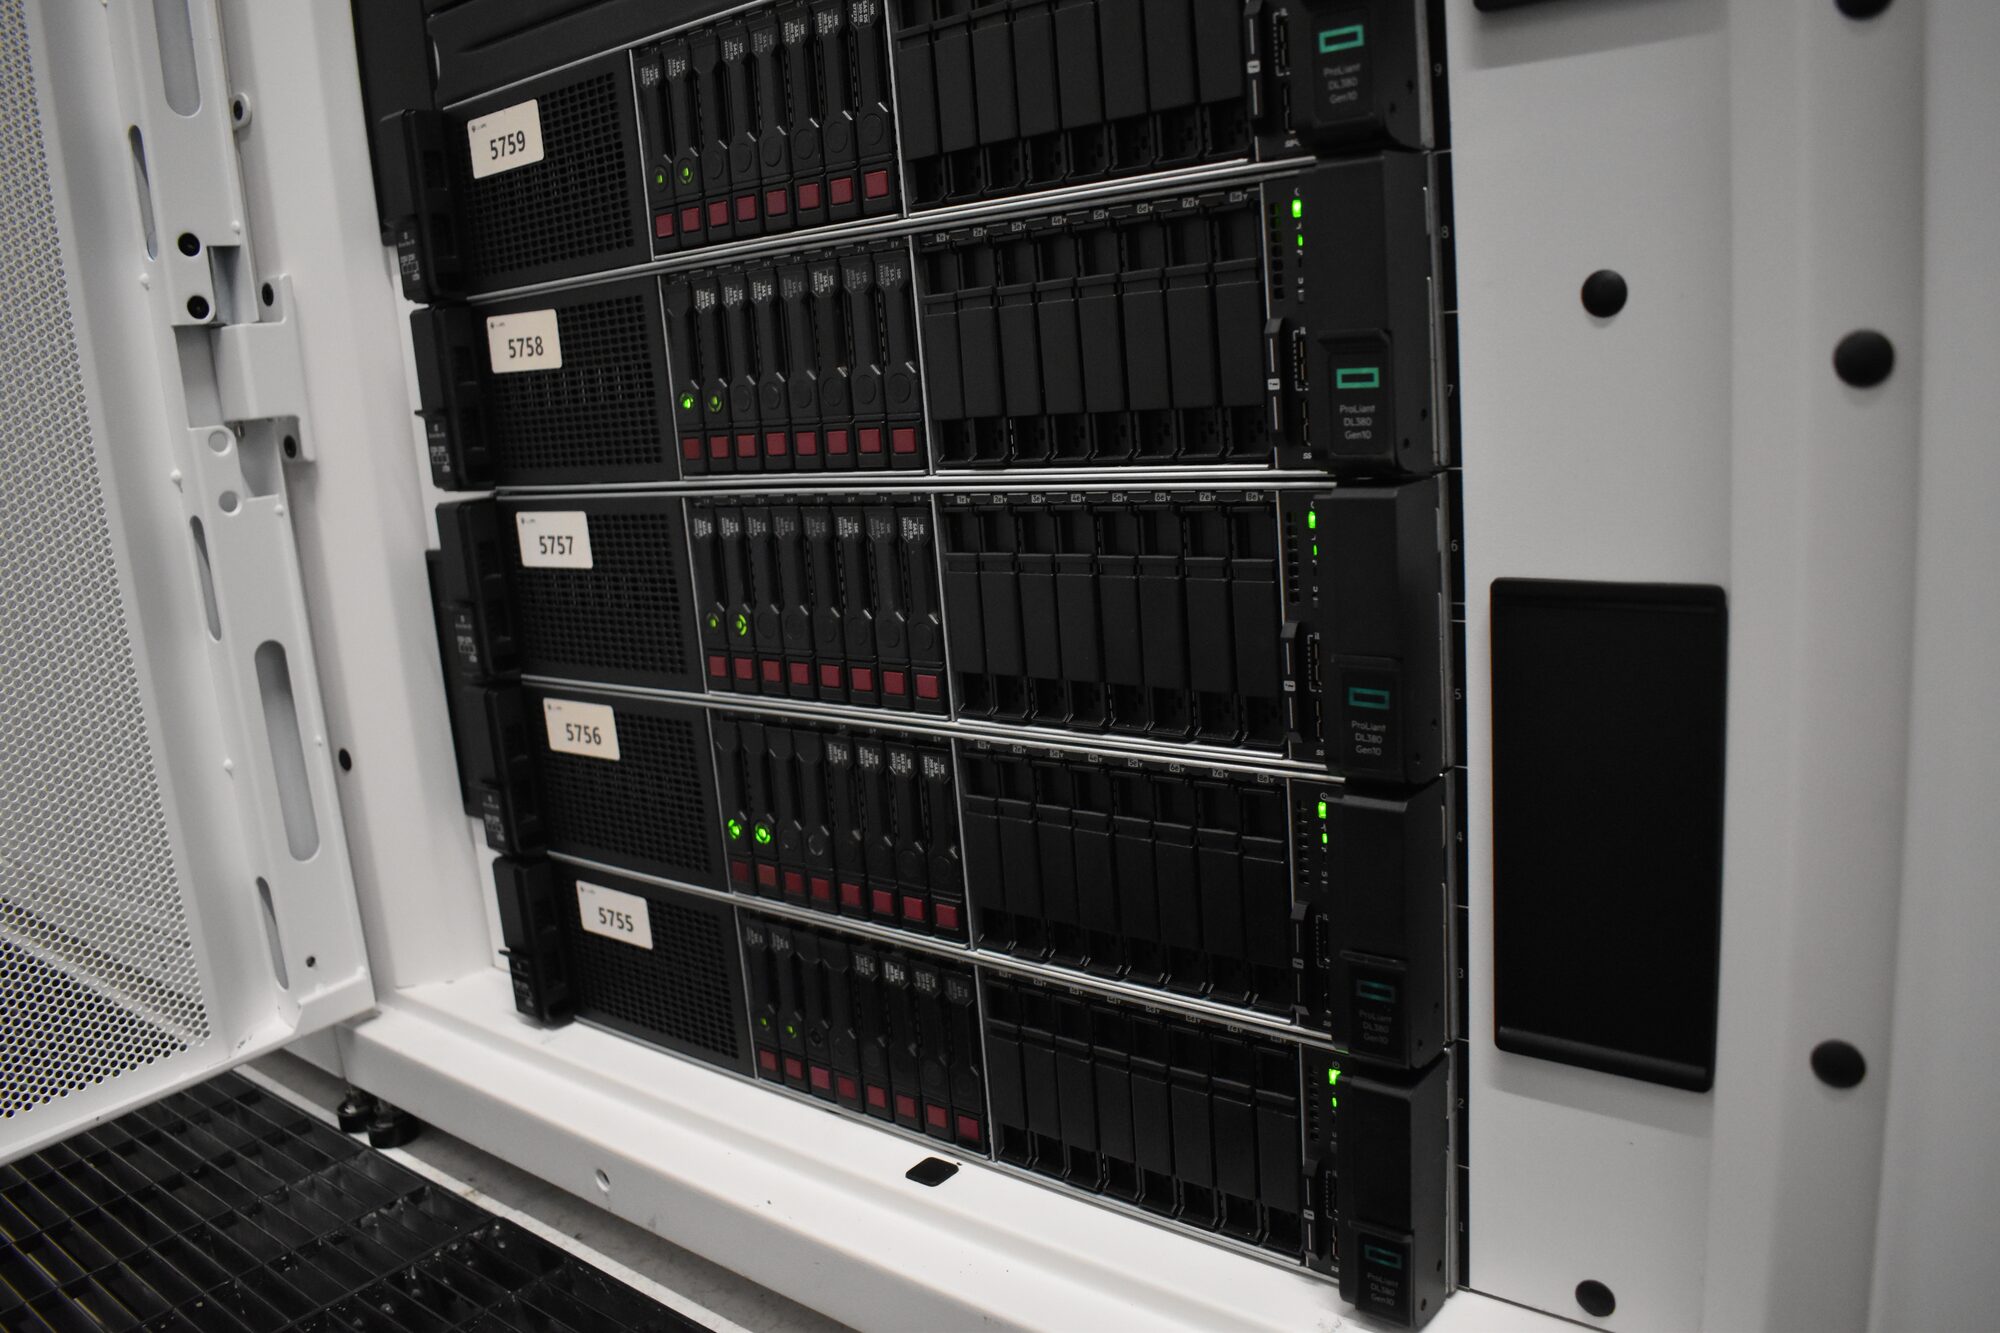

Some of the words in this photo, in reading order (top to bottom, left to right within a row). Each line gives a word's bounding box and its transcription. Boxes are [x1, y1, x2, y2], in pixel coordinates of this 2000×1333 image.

[1323, 62, 1361, 78] ProLiant
[1434, 63, 1442, 77] 9
[1328, 76, 1358, 91] DL380
[1328, 90, 1359, 104] Gen10
[490, 130, 525, 160] 5759
[1441, 225, 1449, 239] 8
[508, 336, 544, 359] 5758
[1448, 384, 1454, 397] 7
[1339, 403, 1376, 414] ProLiant
[1343, 416, 1373, 427] DL380
[1344, 430, 1373, 440] Gen10
[539, 535, 573, 555] 5757
[1451, 539, 1458, 552] 6
[1454, 688, 1462, 700] 5
[1351, 720, 1386, 733] ProLiant
[566, 723, 601, 745] 5756
[1354, 732, 1383, 744] DL380
[1355, 744, 1382, 756] Gen10
[599, 907, 633, 932] 5755
[1457, 967, 1464, 979] 3
[1457, 1098, 1465, 1109] 2
[1459, 1222, 1464, 1233] 1
